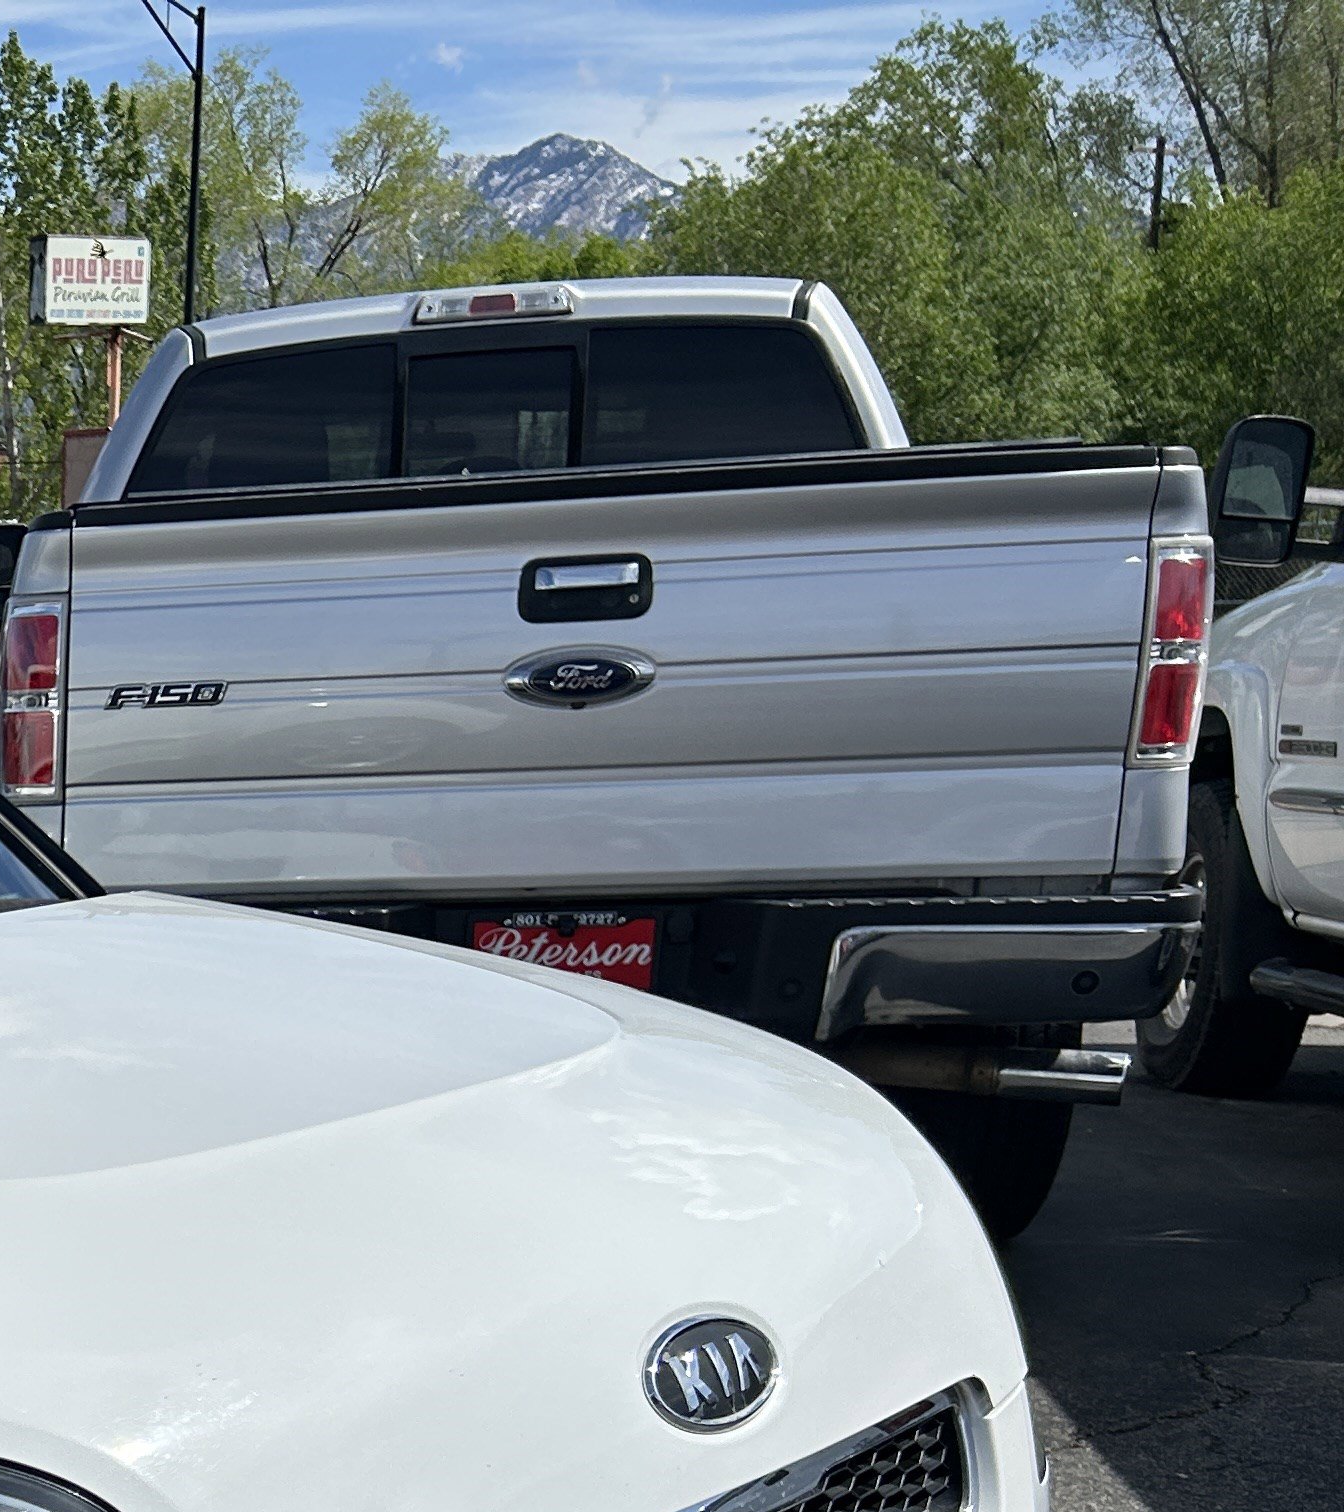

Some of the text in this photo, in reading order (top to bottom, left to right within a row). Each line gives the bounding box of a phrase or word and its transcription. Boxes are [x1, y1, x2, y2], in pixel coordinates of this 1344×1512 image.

[52, 258, 144, 284] PURO PERU
[112, 286, 140, 303] Grill
[550, 664, 613, 691] Ford
[479, 926, 652, 968] Peterson
[662, 1332, 768, 1412] KIA
